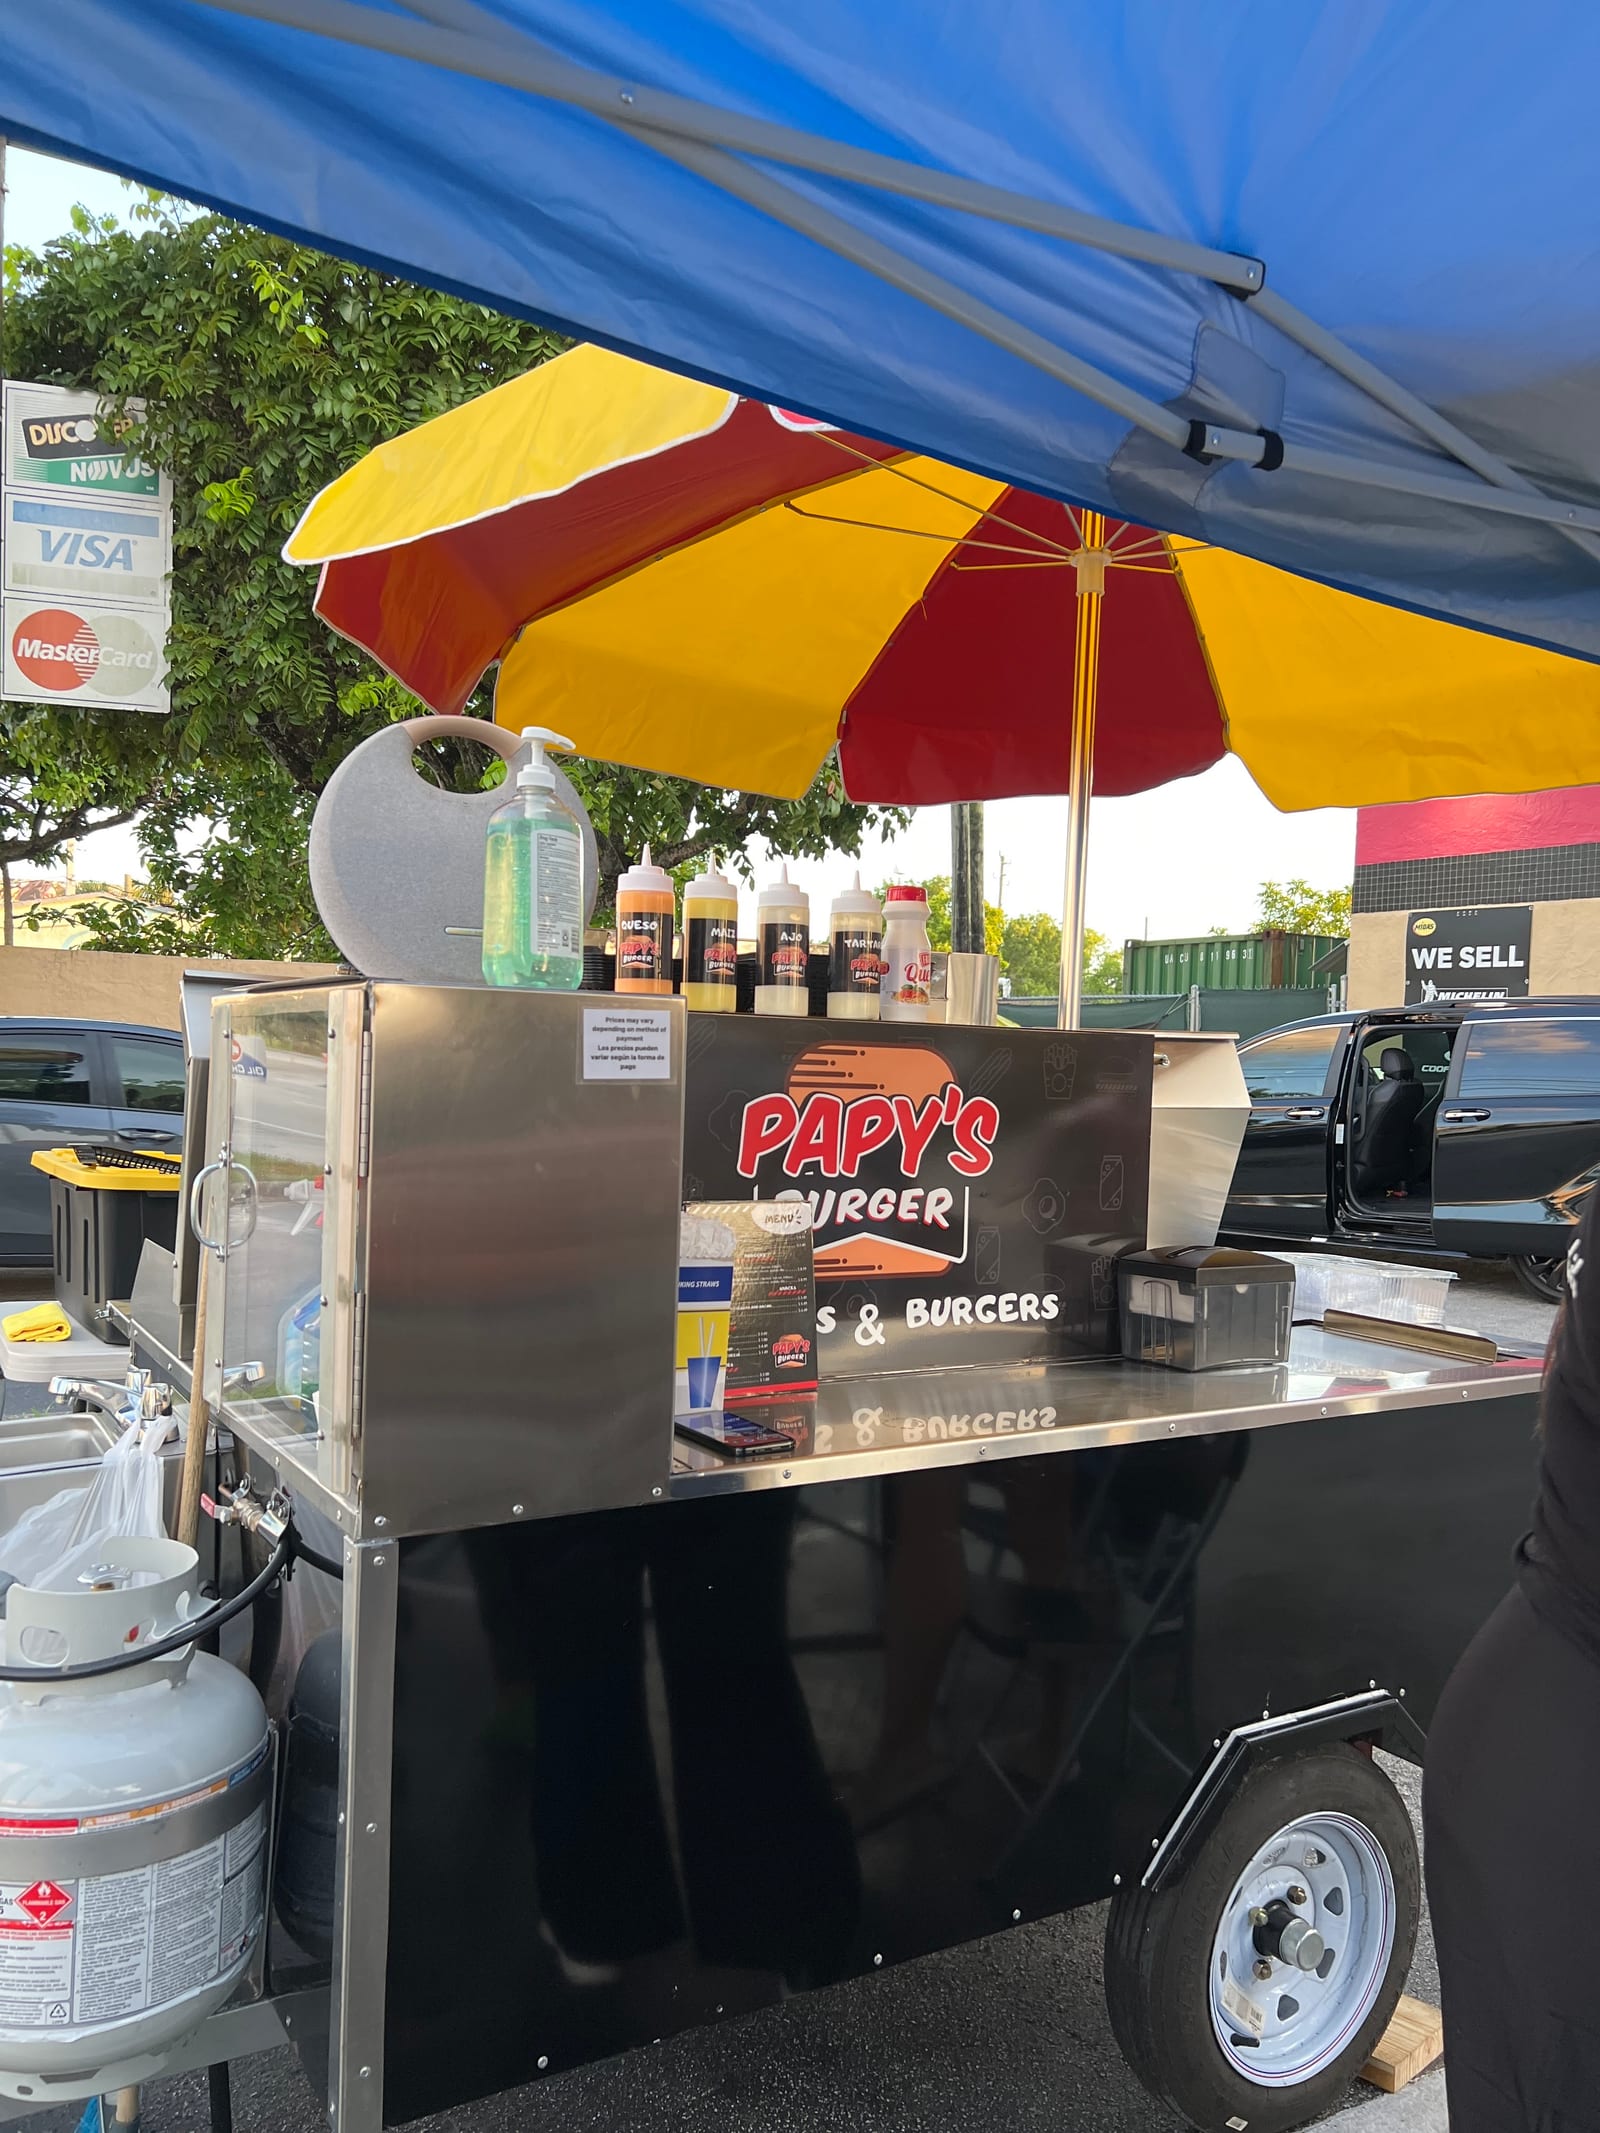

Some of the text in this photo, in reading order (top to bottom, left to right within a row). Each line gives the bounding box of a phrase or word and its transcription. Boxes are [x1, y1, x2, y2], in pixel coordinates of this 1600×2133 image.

[38, 528, 135, 572] VISA
[17, 637, 153, 671] MasterCard
[621, 919, 658, 931] QUESO
[1415, 922, 1434, 931] MIDAS
[711, 927, 736, 939] MAIZ
[780, 931, 803, 942] AJO
[1411, 944, 1525, 970] WE SELL
[1437, 991, 1506, 1001] MICHELIN
[592, 1025, 625, 1033] depending
[736, 1081, 999, 1178] PAPY'S
[764, 1213, 794, 1224] MENU
[854, 1303, 886, 1346] &
[906, 1292, 1060, 1329] BURGERS
[772, 1340, 811, 1356] PAPY'S
[777, 1353, 805, 1364] BURGER
[39, 1910, 47, 1921] 2
